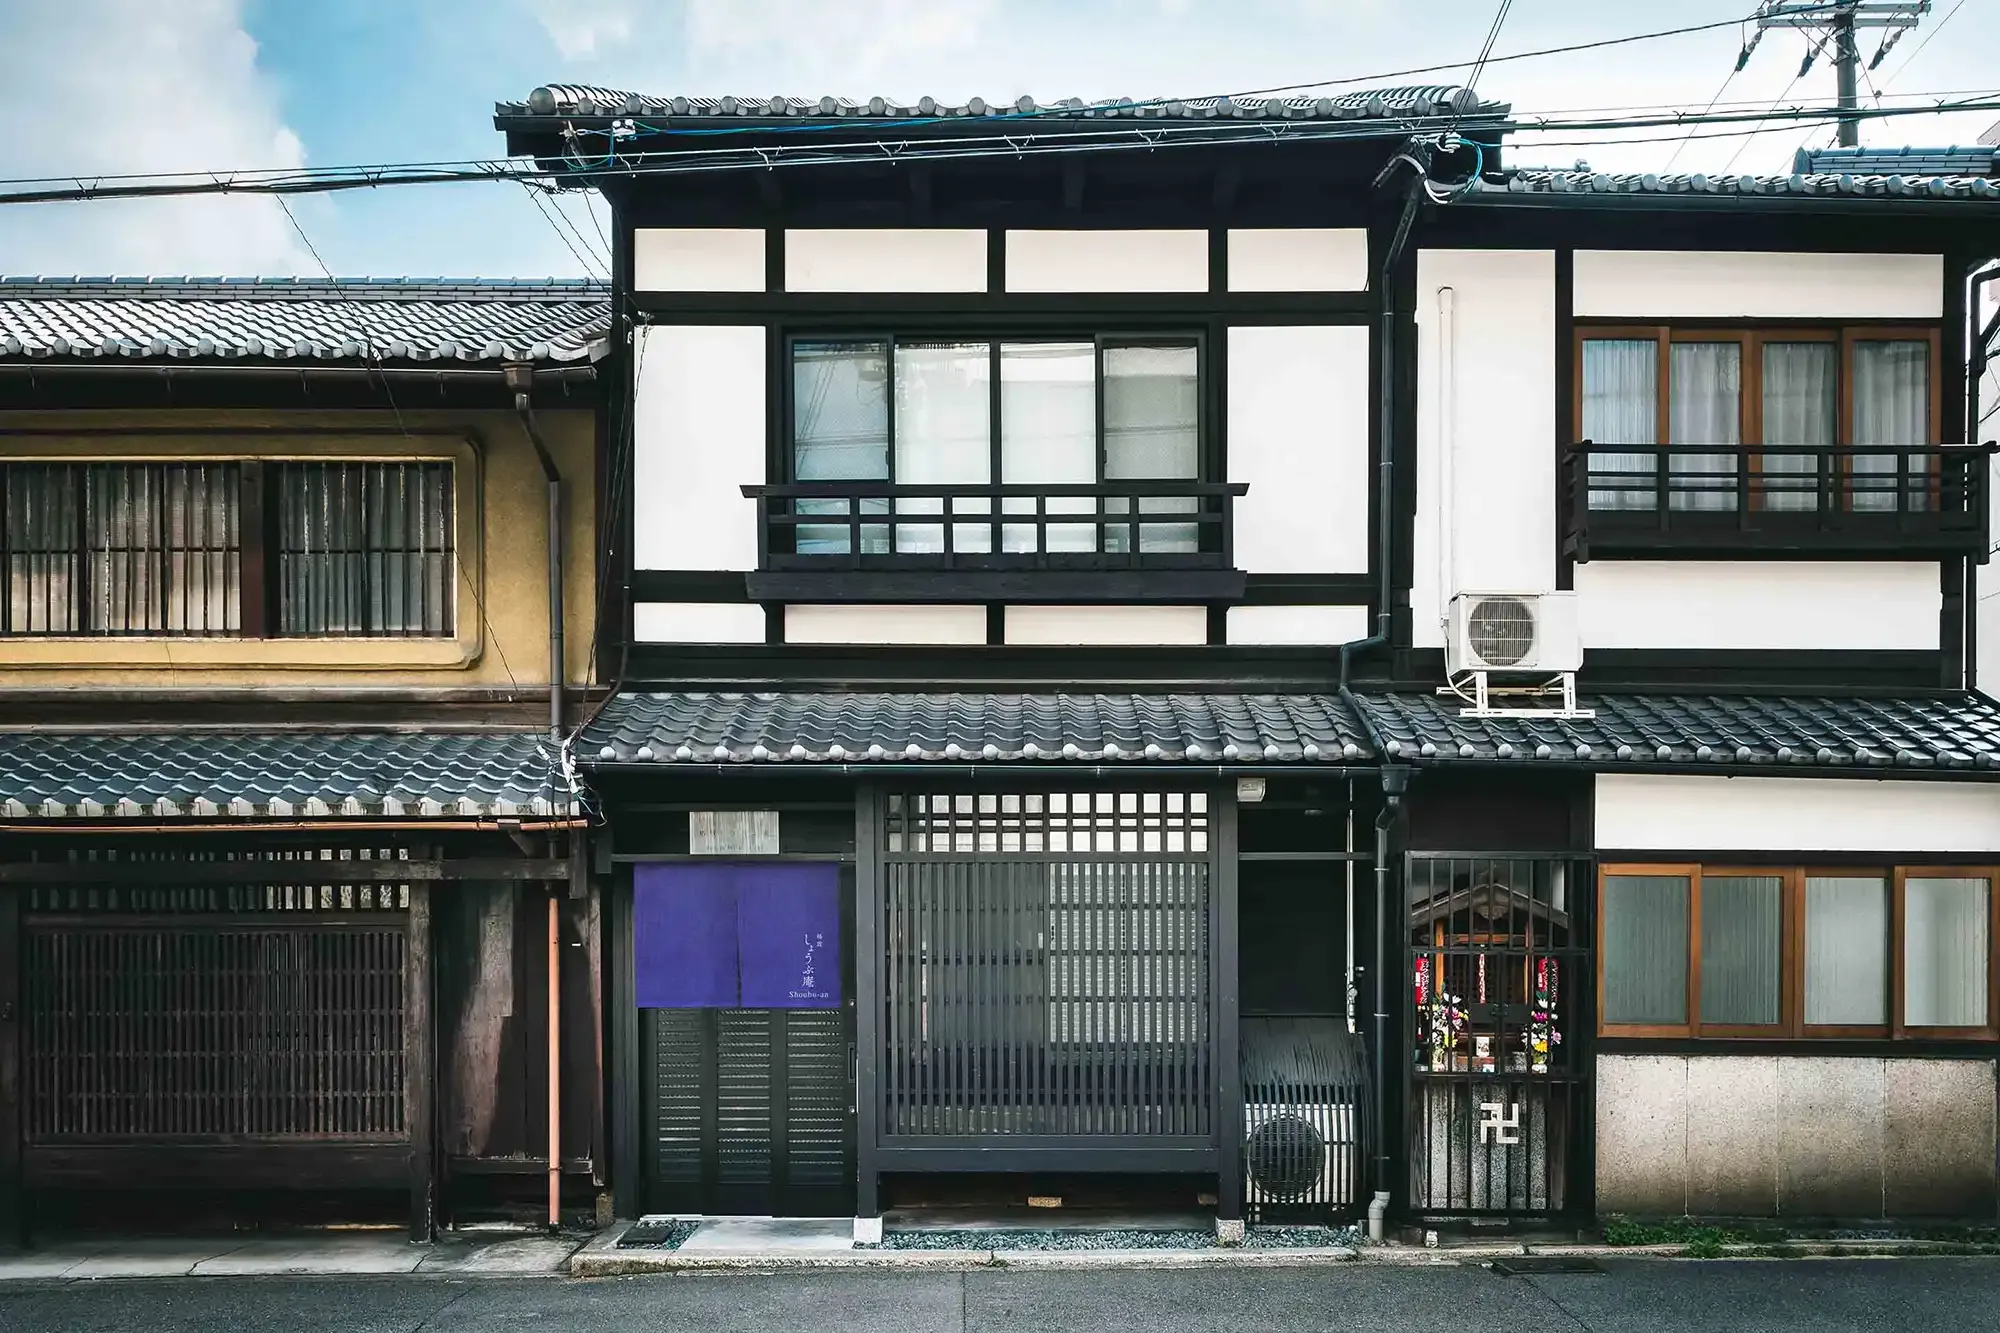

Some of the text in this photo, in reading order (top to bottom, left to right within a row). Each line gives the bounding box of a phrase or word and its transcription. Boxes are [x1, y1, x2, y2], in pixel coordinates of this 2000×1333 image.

[802, 933, 814, 988] しょうぶ庵
